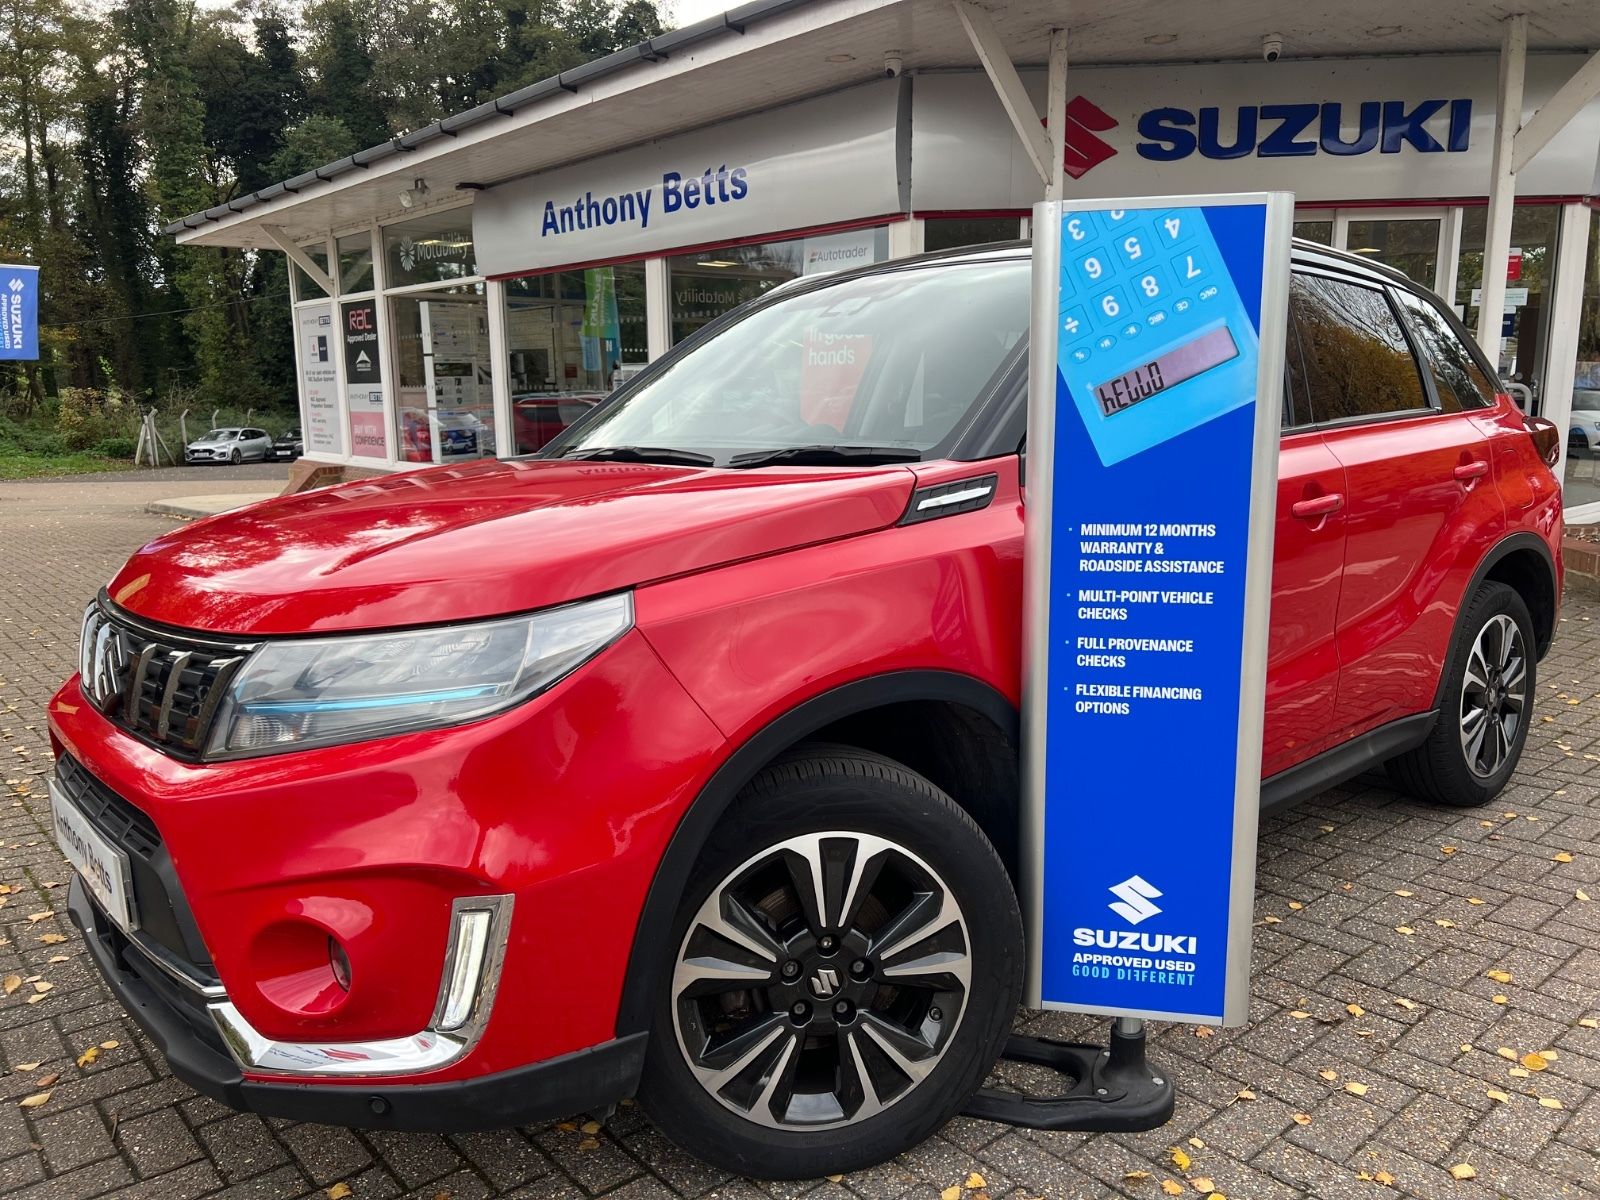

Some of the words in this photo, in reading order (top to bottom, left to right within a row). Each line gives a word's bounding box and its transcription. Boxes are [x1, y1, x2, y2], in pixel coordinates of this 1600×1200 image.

[1136, 99, 1472, 161] SUZUKI
[541, 190, 652, 237] Anthony
[663, 164, 748, 214] Betts
[1068, 218, 1085, 240] 3
[1164, 218, 1180, 240] 4
[416, 232, 468, 261] Motability
[818, 246, 868, 263] Autotrader
[1124, 237, 1142, 260] 5
[1084, 257, 1101, 279] 6
[1186, 256, 1201, 279] 7
[1141, 276, 1160, 297] 8
[1102, 295, 1120, 317] 9
[1176, 300, 1189, 312] CE
[10, 294, 22, 350] SUZUKI
[1148, 312, 1164, 325] MRC
[808, 343, 855, 366] hands
[1080, 523, 1142, 537] MINIMUM
[1143, 524, 1158, 537] 12
[1159, 524, 1216, 537] MONTHS
[1080, 541, 1152, 554] WARRANTY
[1154, 542, 1164, 555] &
[1079, 559, 1143, 573] ROADSIDE
[1144, 560, 1225, 574] ASSISTANCE
[1078, 589, 1160, 603] MULTI-POINT
[1161, 591, 1214, 605] VEHICLE
[1077, 607, 1128, 621] CHECKS
[1077, 637, 1107, 650] FULL
[1108, 638, 1194, 653] PROVENANCE
[1076, 654, 1126, 668] CHECKS
[1075, 683, 1131, 698] FLEXIBLE
[1132, 686, 1202, 701] FINANCING
[1074, 701, 1130, 715] OPTIONS
[55, 805, 87, 867] Anthony
[87, 842, 112, 894] Betts
[1073, 927, 1197, 955] SUZUKI
[1073, 953, 1152, 969] APPROVED
[1155, 959, 1196, 972] USED
[1072, 964, 1109, 977] GOOD
[1117, 968, 1195, 986] DIFFERENT
